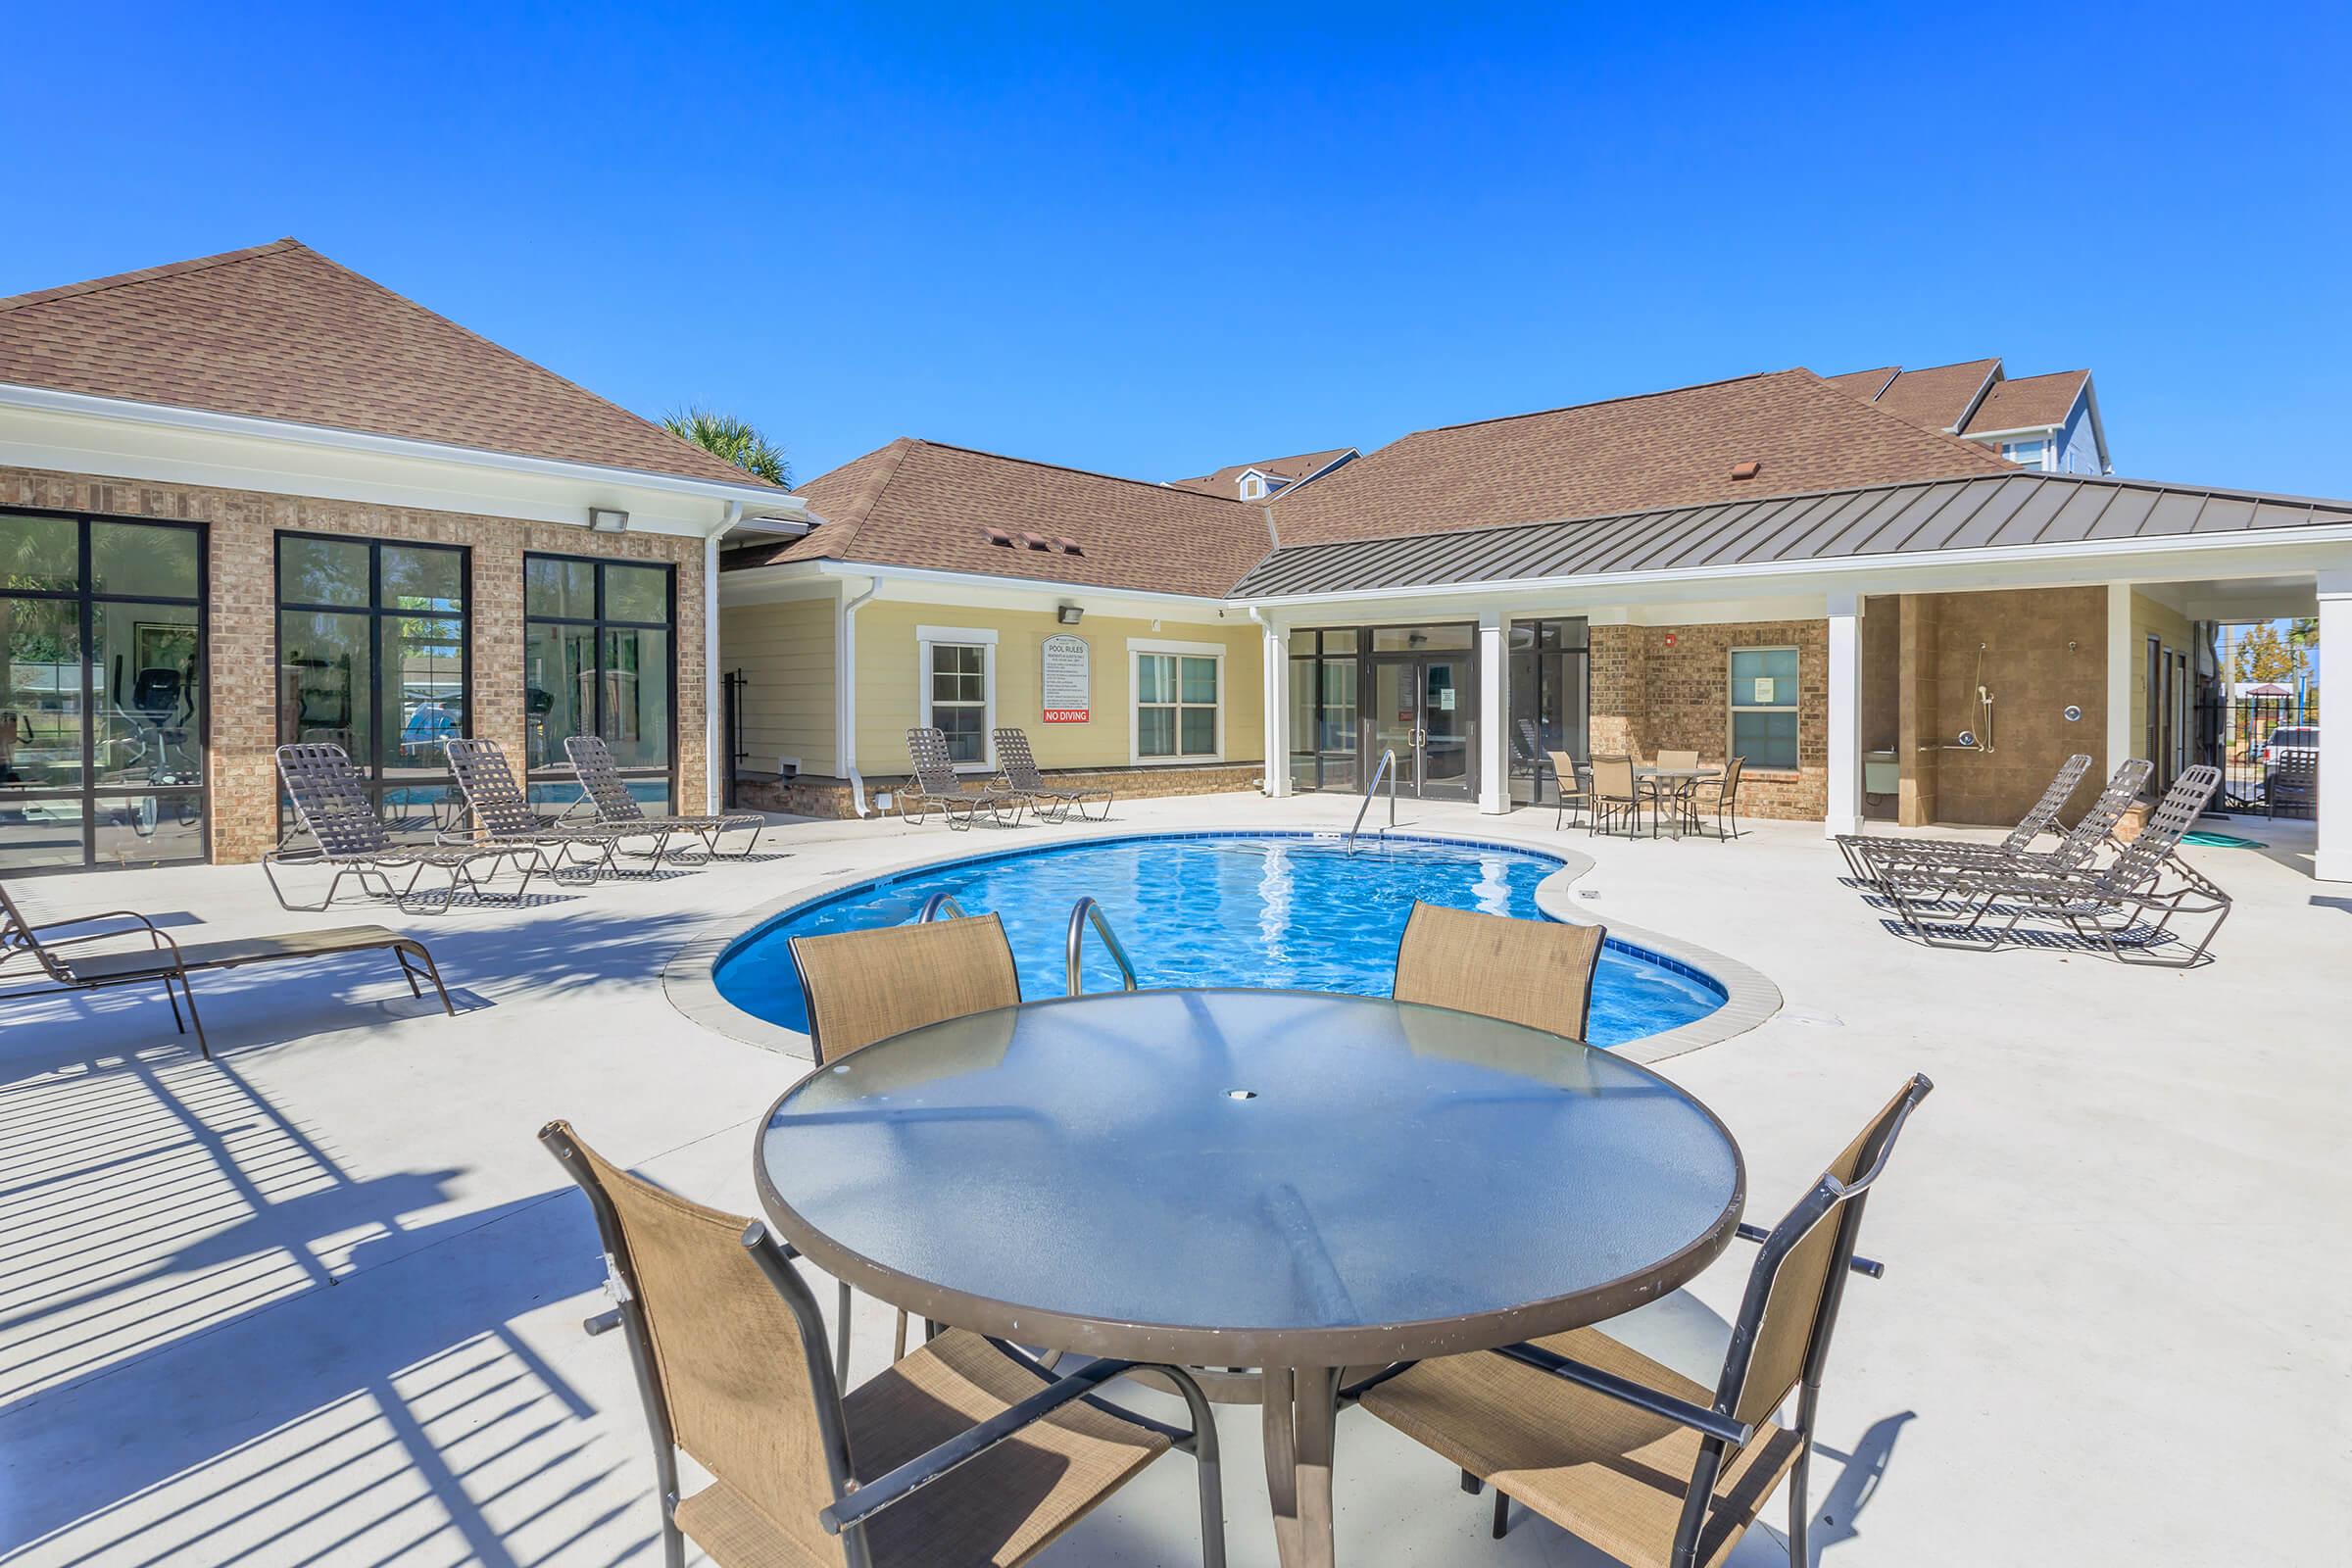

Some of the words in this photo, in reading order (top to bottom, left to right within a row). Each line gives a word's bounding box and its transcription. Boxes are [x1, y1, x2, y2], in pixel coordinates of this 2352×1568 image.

[1065, 645, 1084, 654] RULES
[1046, 711, 1058, 720] NO
[1059, 711, 1086, 721] DIVING
